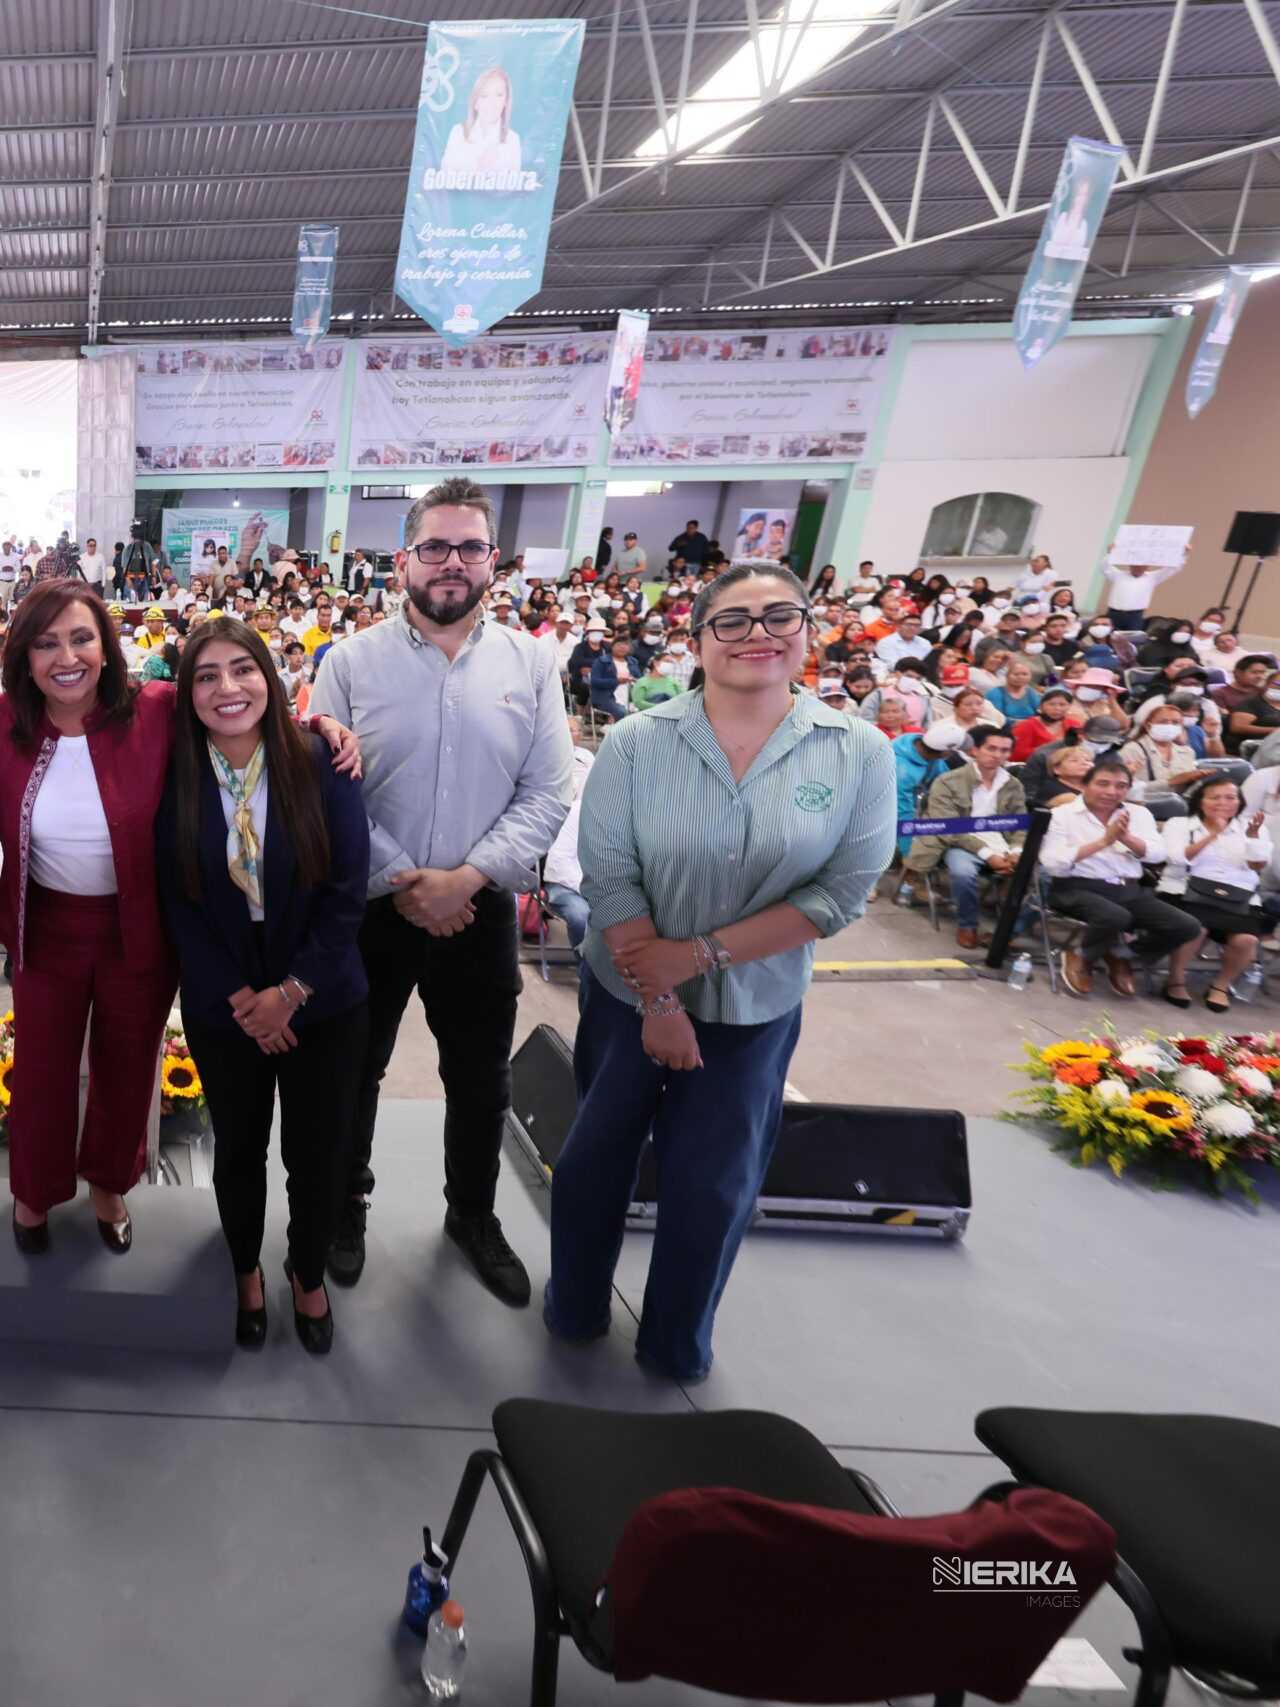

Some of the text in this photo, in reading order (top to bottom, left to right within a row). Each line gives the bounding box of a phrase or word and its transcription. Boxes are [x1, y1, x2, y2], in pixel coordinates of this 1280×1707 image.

[423, 168, 538, 192] Gobernadora
[415, 222, 468, 242] Lorena
[449, 243, 502, 267] ejemplo
[400, 265, 455, 288] trabajo
[456, 270, 470, 288] y
[395, 378, 417, 389] Con
[418, 378, 457, 390] trabajo
[459, 379, 472, 388] en
[474, 377, 512, 390] equipo
[478, 394, 508, 407] sigue
